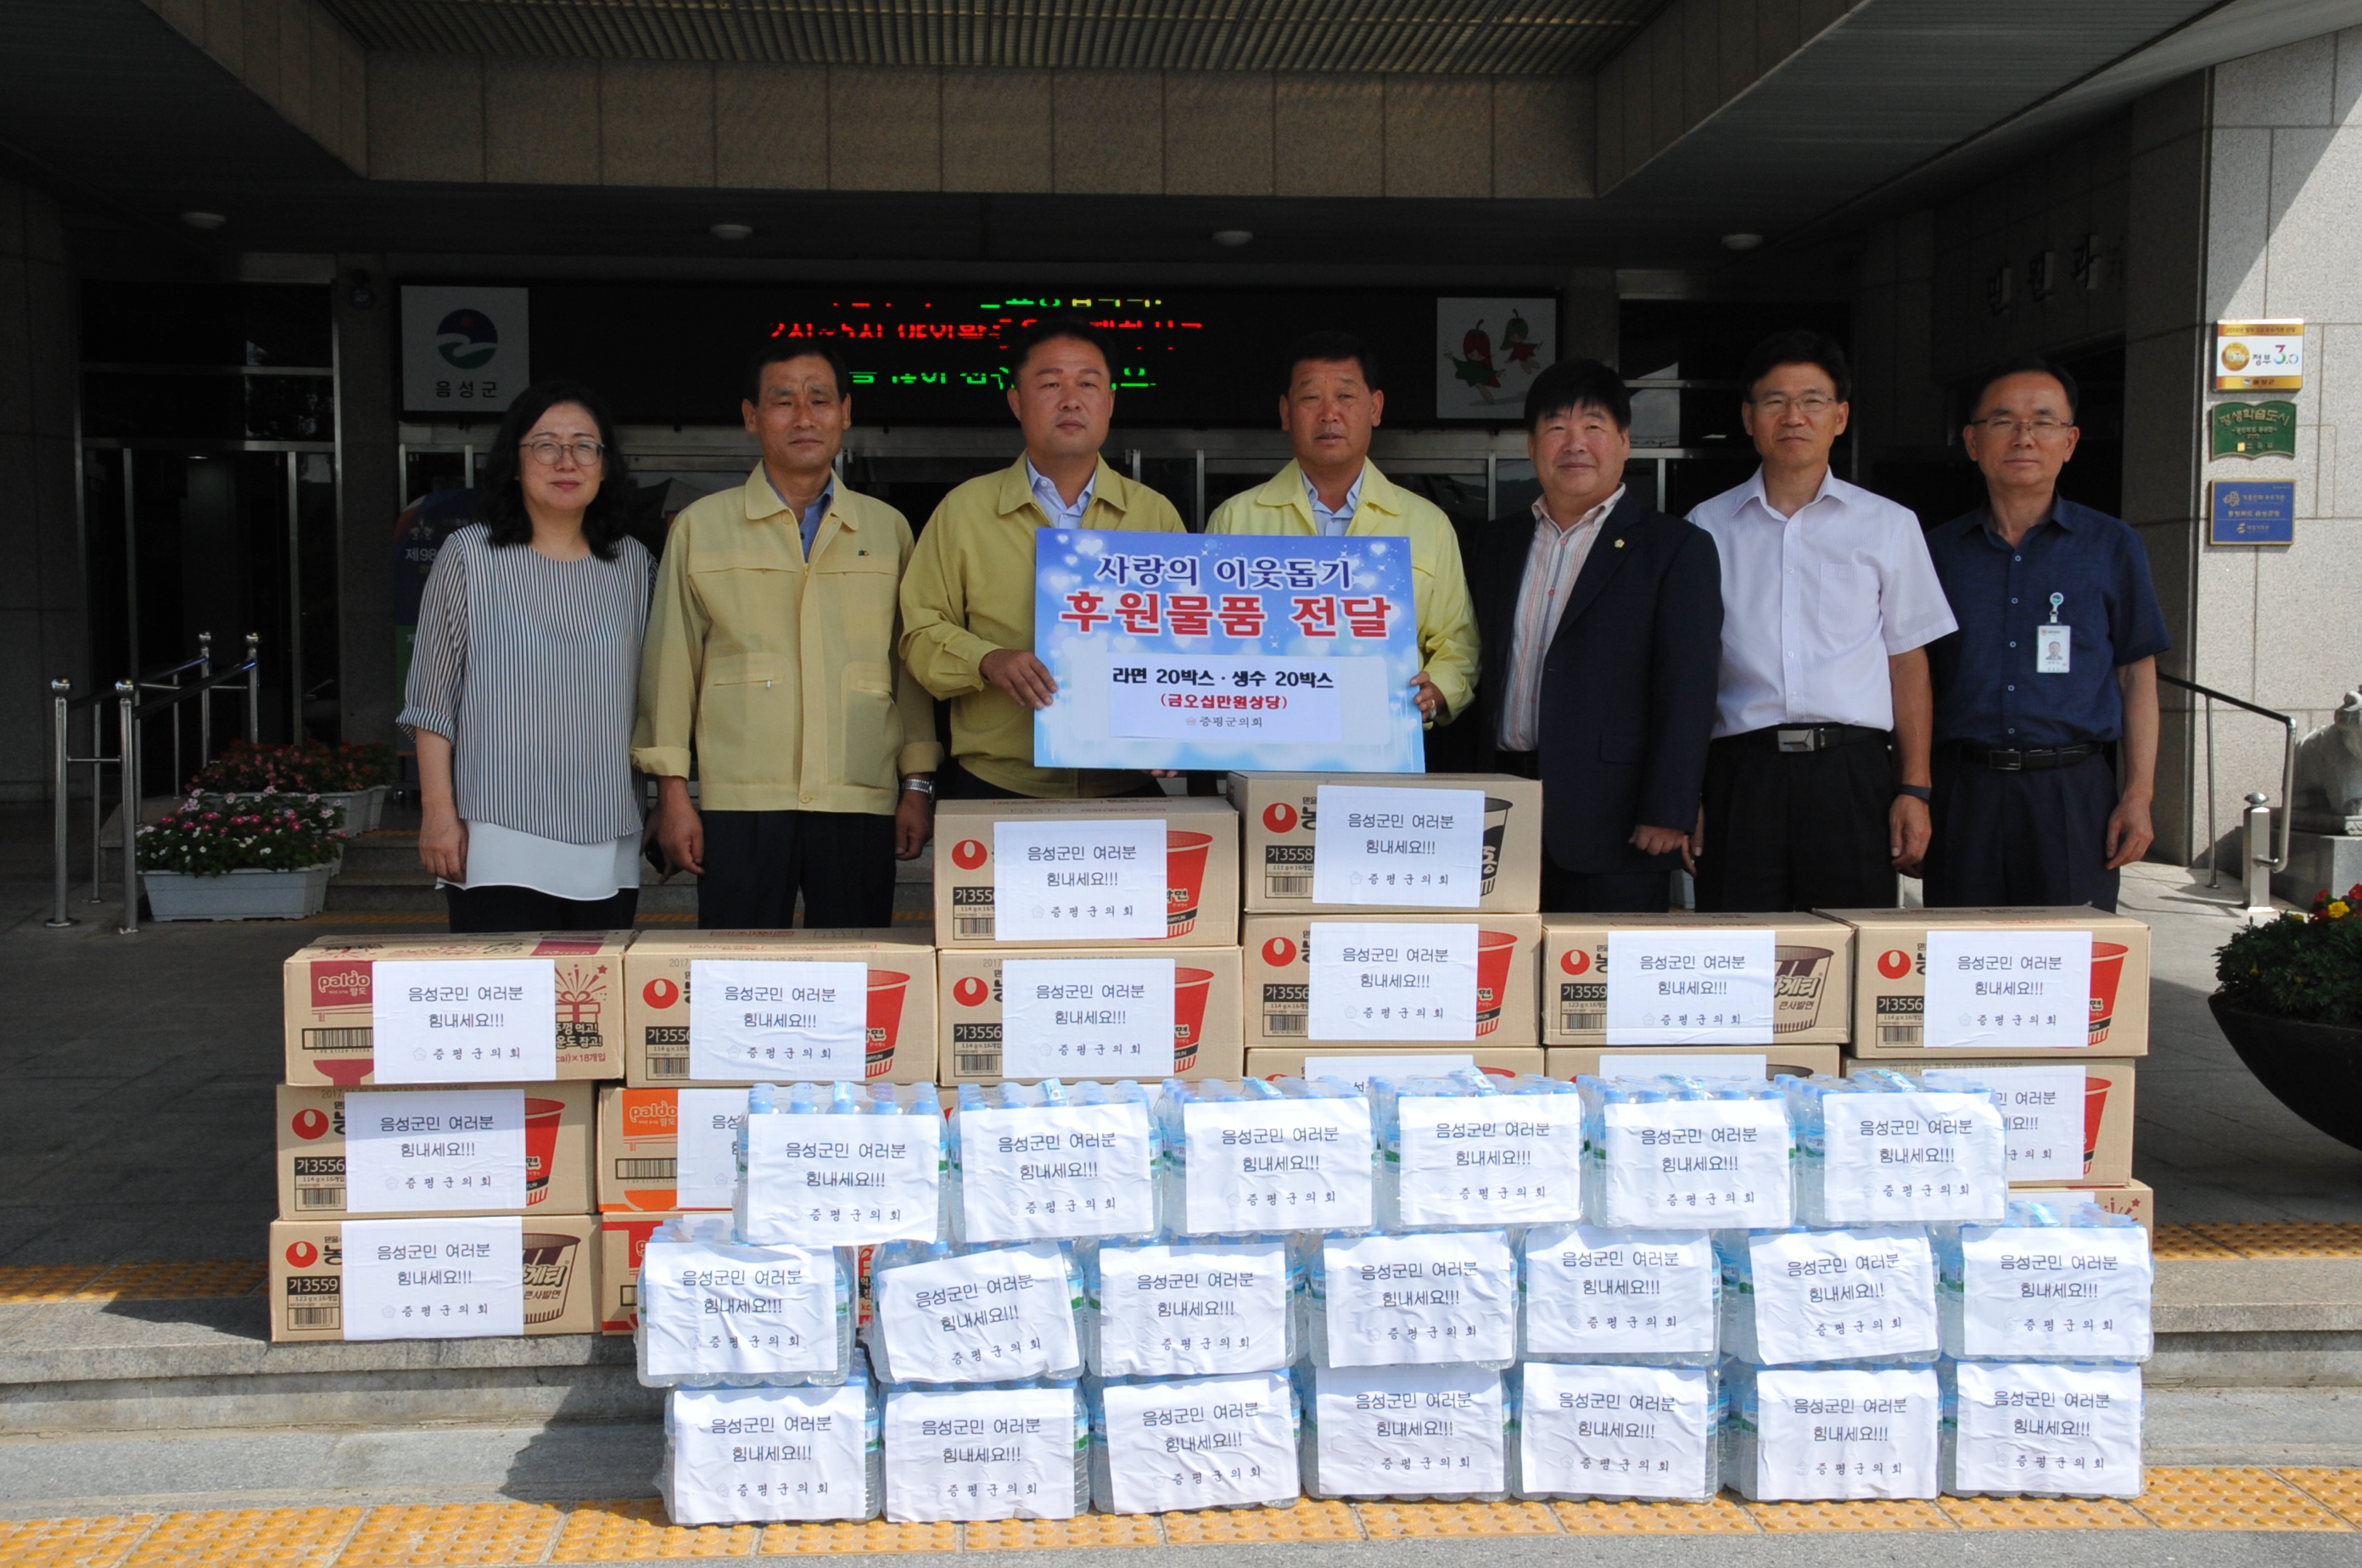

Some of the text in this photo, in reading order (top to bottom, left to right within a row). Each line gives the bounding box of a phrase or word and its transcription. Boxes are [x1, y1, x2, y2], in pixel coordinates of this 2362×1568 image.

[2253, 344, 2299, 366] 정부 3.0
[436, 379, 499, 399] 음성군
[1098, 555, 1352, 590] 사랑의 이웃돕기
[1059, 591, 1392, 637] 후원물품 전달
[1112, 667, 1335, 689] 라면 20박스 생수 20박스
[1161, 693, 1288, 711] (금오십만원상당)
[1199, 716, 1263, 729] 증평군의회
[1347, 813, 1454, 830] 음성군민 여러분
[1027, 845, 1137, 861] 음성군민 여러분
[1268, 848, 1313, 862] 가3558
[1366, 839, 1436, 855] 힘내세요!!!
[1047, 871, 1118, 888] 힘내세요!!!
[1368, 872, 1449, 886] 증평군의회
[1050, 904, 1133, 919] 증평군의회
[1342, 947, 1449, 963] 음성군민 여러분
[1639, 955, 1746, 971] 음성군민 여러분
[1957, 955, 2063, 971] 음성군민 여러분
[317, 970, 370, 994] paldo
[1360, 973, 1430, 988] 힘내세요!!!
[1658, 981, 1727, 995] 힘내세요!!!
[1975, 981, 2043, 996] 힘내세요!!!
[350, 987, 367, 997] 팔도
[408, 986, 523, 1002] 음성군민 여러분
[724, 986, 837, 1003] 음성군민 여러분
[1036, 984, 1145, 1000] 음성군민 여러분
[1563, 985, 1608, 999] 가3559
[1363, 1006, 1443, 1019] 증평군의회
[1878, 998, 1923, 1011] 가3556
[428, 1012, 504, 1028] 힘내세요!!!
[743, 1012, 816, 1028] 힘내세요!!!
[1055, 1010, 1126, 1025] 힘내세요!!!
[1660, 1013, 1741, 1026] 증평군의회
[1977, 1014, 2057, 1027] 증평군의회
[575, 1022, 599, 1034] 먹고!
[956, 1026, 1002, 1039] 가3556
[579, 1036, 603, 1048] 잡고!
[1058, 1043, 1140, 1056] 증평군의회
[433, 1046, 520, 1061] 증평군의회
[747, 1046, 831, 1060] 증평군의회
[2016, 1091, 2057, 1106] 여러분
[630, 1101, 677, 1123] paldo
[380, 1115, 495, 1132] 음성군민 여러분
[1436, 1122, 1551, 1139] 음성군민 여러분
[1860, 1117, 1973, 1136] 음성군민 여러분
[998, 1132, 1117, 1153] 음성군민 여러분
[1221, 1126, 1340, 1145] 음성군민 여러분
[1641, 1127, 1758, 1145] 음성군민 여러분
[400, 1142, 475, 1158] 힘내세요!!!
[785, 1142, 907, 1160] 음성군민 여러분
[1455, 1150, 1531, 1167] 힘내세요!!!
[1879, 1147, 1954, 1164] 힘내세요!!!
[297, 1159, 345, 1173] 가3556
[1020, 1162, 1098, 1181] 힘내세요!!!
[1242, 1155, 1319, 1173] 힘내세요!!!
[1661, 1156, 1738, 1173] 힘내세요!!!
[405, 1175, 491, 1190] 증평군의회
[806, 1171, 885, 1188] 힘내세요!!!
[1246, 1190, 1335, 1207] 증평군의회
[1459, 1185, 1545, 1201] 증평군의회
[1666, 1190, 1755, 1207] 증평군의회
[1883, 1183, 1969, 1198] 증평군의회
[1025, 1196, 1116, 1215] 증평군의회
[809, 1207, 901, 1222] 증평군의회
[377, 1242, 491, 1261] 음성군민 여러분
[1561, 1251, 1679, 1268] 음성군민 여러분
[1360, 1261, 1478, 1281] 음성군민 여러분
[1787, 1252, 1900, 1278] 음성군민 여러분
[2000, 1254, 2119, 1271] 음성군민 여러분
[289, 1279, 339, 1292] 가3559
[397, 1269, 472, 1286] 힘내세요!!!
[682, 1269, 803, 1286] 음성군민 여러분
[1137, 1272, 1255, 1291] 음성군민 여러분
[915, 1274, 1034, 1309] 음성군민 여러분
[1582, 1279, 1660, 1296] 힘내세요!!!
[1809, 1282, 1884, 1303] 힘내세요!!!
[2021, 1282, 2097, 1299] 힘내세요!!!
[703, 1298, 782, 1314] 힘내세요!!!
[1382, 1289, 1460, 1308] 힘내세요!!!
[401, 1302, 488, 1318] 증평군의회
[1157, 1300, 1234, 1318] 힘내세요!!!
[941, 1305, 1019, 1331] 힘내세요!!!
[1587, 1315, 1676, 1330] 증평군의회
[1815, 1316, 1901, 1337] 증평군의회
[2023, 1318, 2113, 1332] 증평군의회
[1387, 1324, 1476, 1341] 증평군의회
[708, 1334, 799, 1349] 증평군의회
[1161, 1336, 1250, 1352] 증평군의회
[951, 1337, 1041, 1365] 증평군의회
[1355, 1392, 1472, 1410] 음성군민 여러분
[1559, 1392, 1676, 1413] 음성군민 여러분
[1793, 1397, 1907, 1414] 음성군민 여러분
[1994, 1391, 2111, 1409] 음성군민 여러분
[1142, 1401, 1262, 1427] 음성군민 여러분
[711, 1415, 832, 1435] 음성군민 여러분
[921, 1418, 1041, 1436] 음성군민 여러분
[1376, 1420, 1453, 1437] 힘내세요!!!
[1578, 1420, 1654, 1439] 힘내세요!!!
[1813, 1425, 1888, 1442] 힘내세요!!!
[2013, 1419, 2090, 1436] 힘내세요!!!
[1164, 1431, 1242, 1455] 힘내세요!!!
[732, 1445, 812, 1463] 힘내세요!!!
[943, 1446, 1021, 1464] 힘내세요!!!
[1380, 1455, 1470, 1470] 증평군의회
[2016, 1451, 2104, 1470] 증평군의회
[1579, 1455, 1669, 1473] 증평군의회
[1816, 1462, 1901, 1476] 증평군의회
[1172, 1465, 1261, 1488] 증평군의회
[736, 1481, 828, 1498] 증평군의회
[947, 1481, 1037, 1498] 증평군의회
